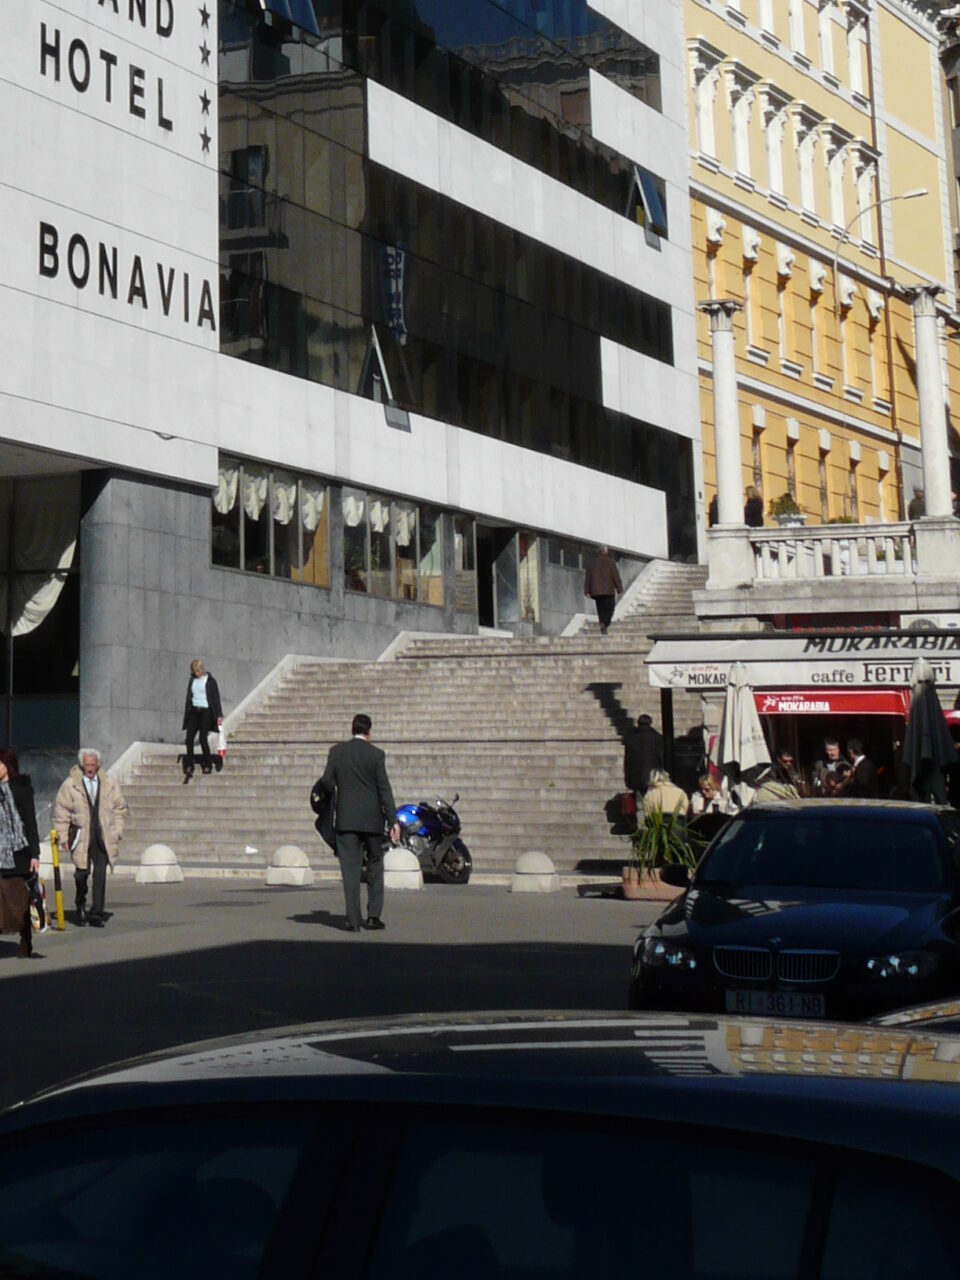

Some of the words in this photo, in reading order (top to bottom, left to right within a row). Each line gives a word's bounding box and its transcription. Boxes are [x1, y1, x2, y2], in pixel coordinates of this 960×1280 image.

[40, 22, 173, 131] HOTEL
[39, 221, 217, 331] BONAVIA
[811, 669, 855, 682] caffe
[862, 662, 951, 682] Ferrri
[778, 701, 830, 711] MOKARABIA
[736, 992, 752, 1010] RI
